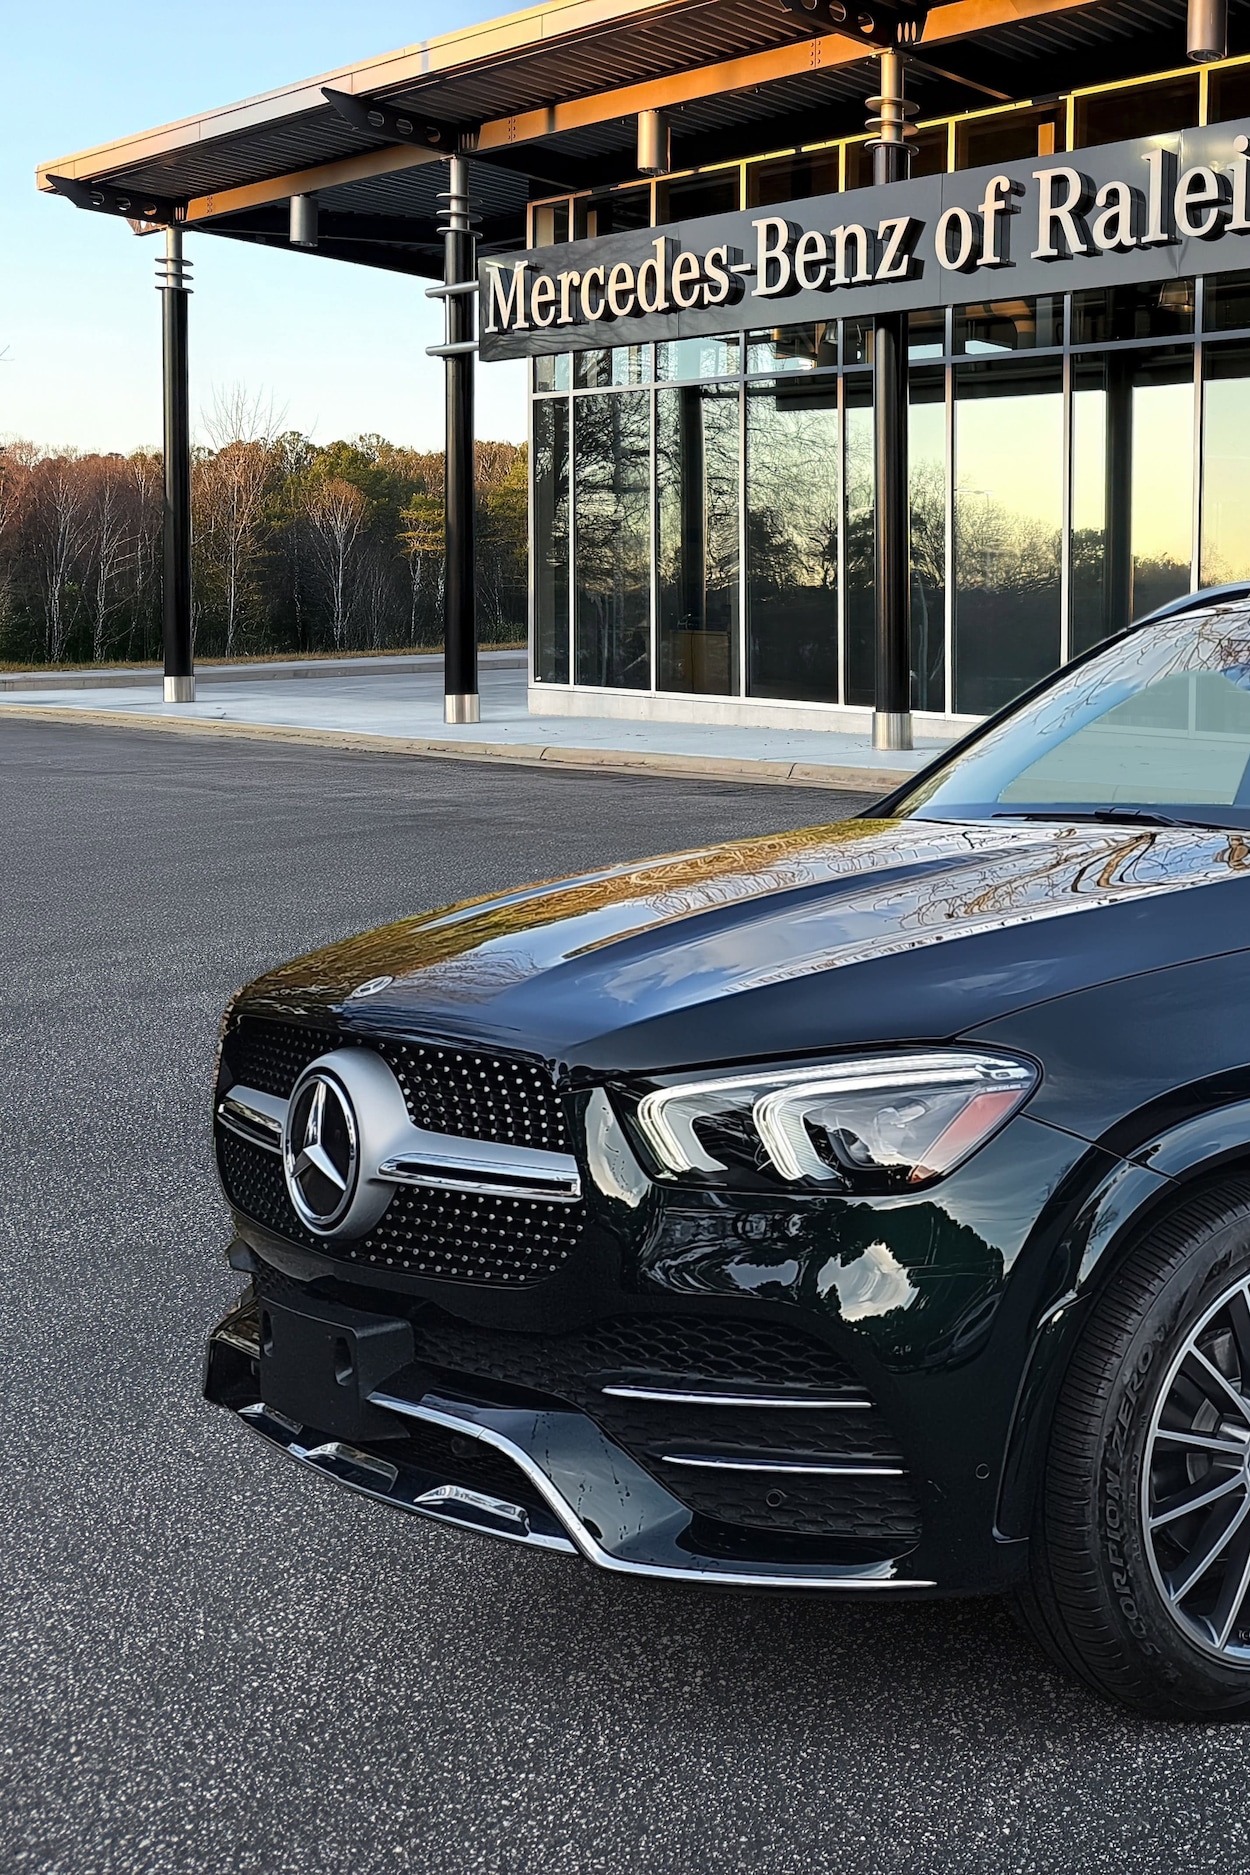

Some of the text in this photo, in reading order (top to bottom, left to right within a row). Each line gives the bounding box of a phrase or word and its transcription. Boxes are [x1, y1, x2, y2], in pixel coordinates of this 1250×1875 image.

[484, 215, 913, 334] Mercedes-Benz
[934, 174, 1011, 271] of
[1111, 1342, 1154, 1459] ZERO
